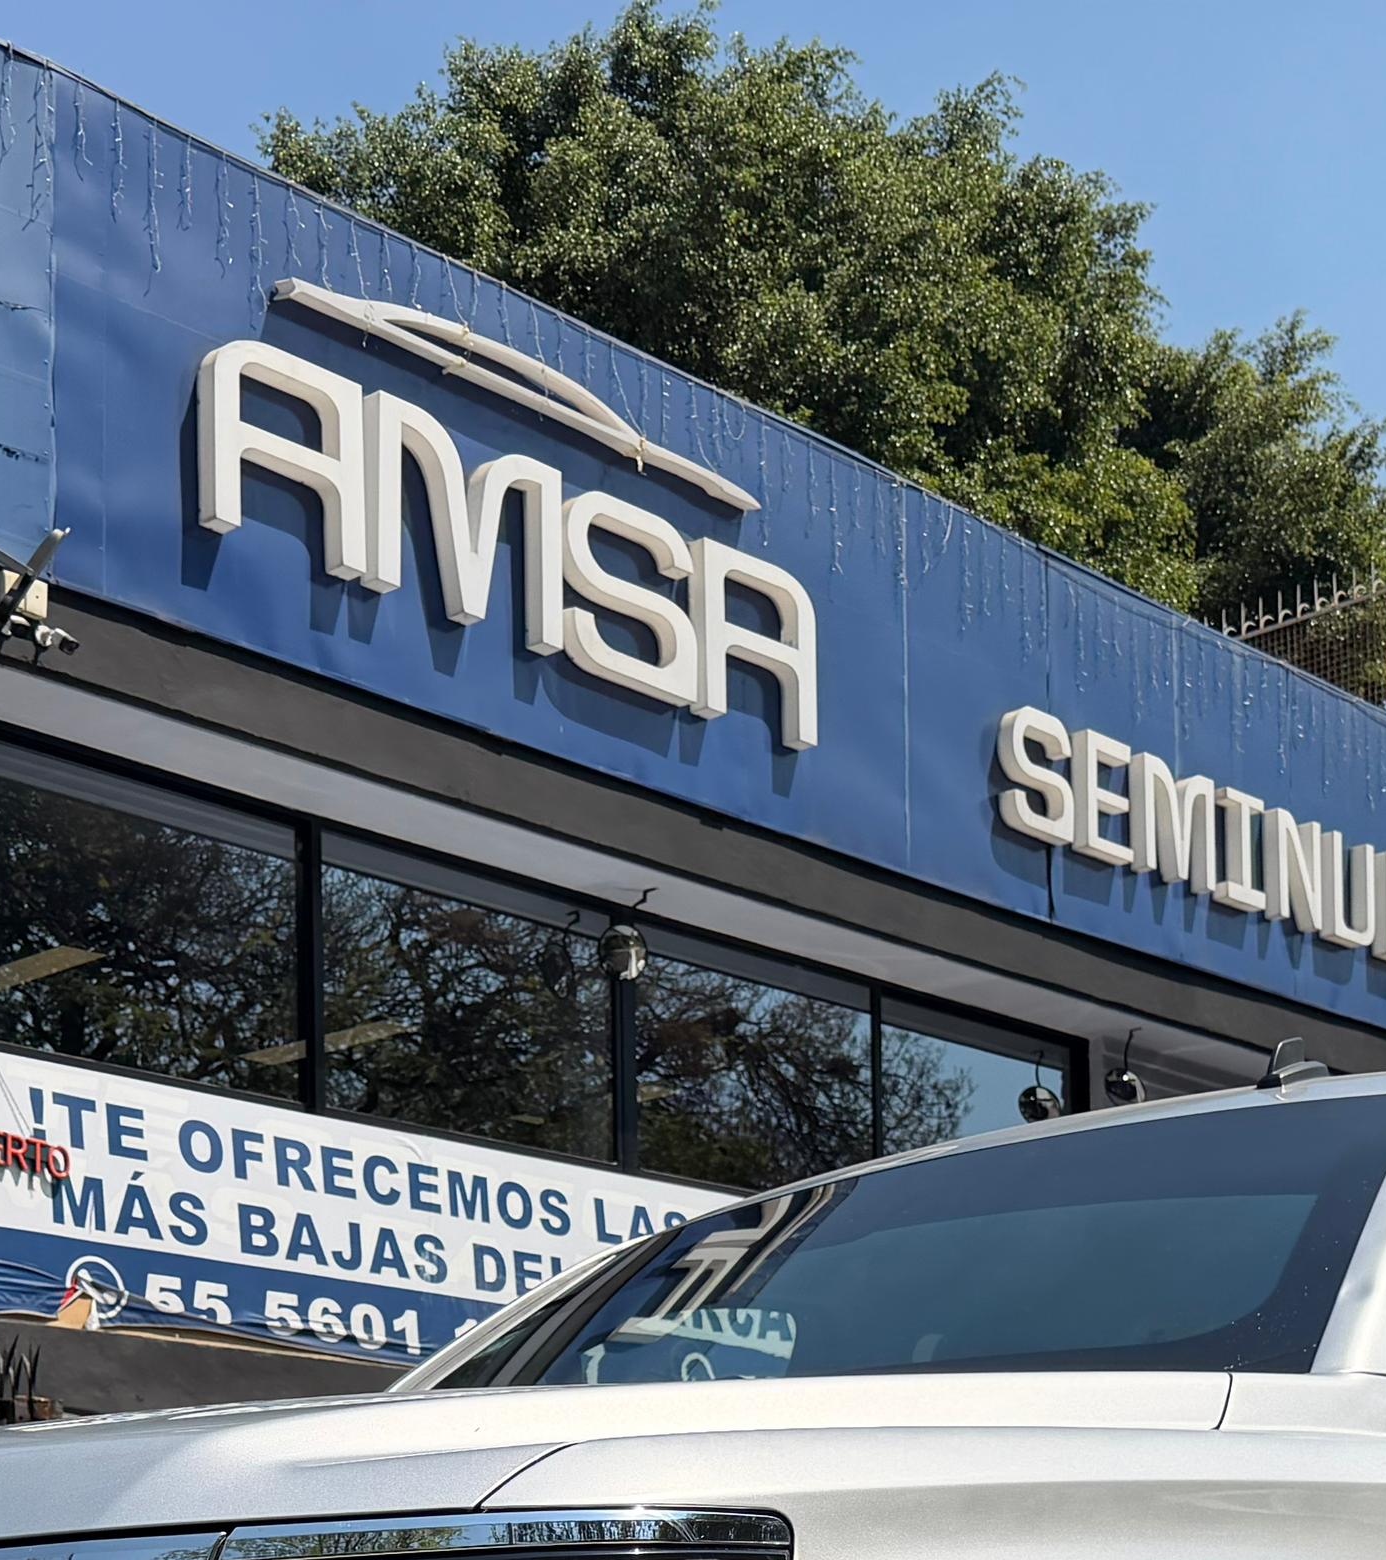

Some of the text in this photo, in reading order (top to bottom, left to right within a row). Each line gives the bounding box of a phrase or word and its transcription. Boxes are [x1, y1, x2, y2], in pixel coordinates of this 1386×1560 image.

[197, 340, 817, 751] AMSA
[51, 1171, 209, 1246] MÁS
[237, 1202, 448, 1284] BAJAS
[180, 1119, 571, 1237] OFRECEMOS
[264, 1290, 422, 1355] 5601
